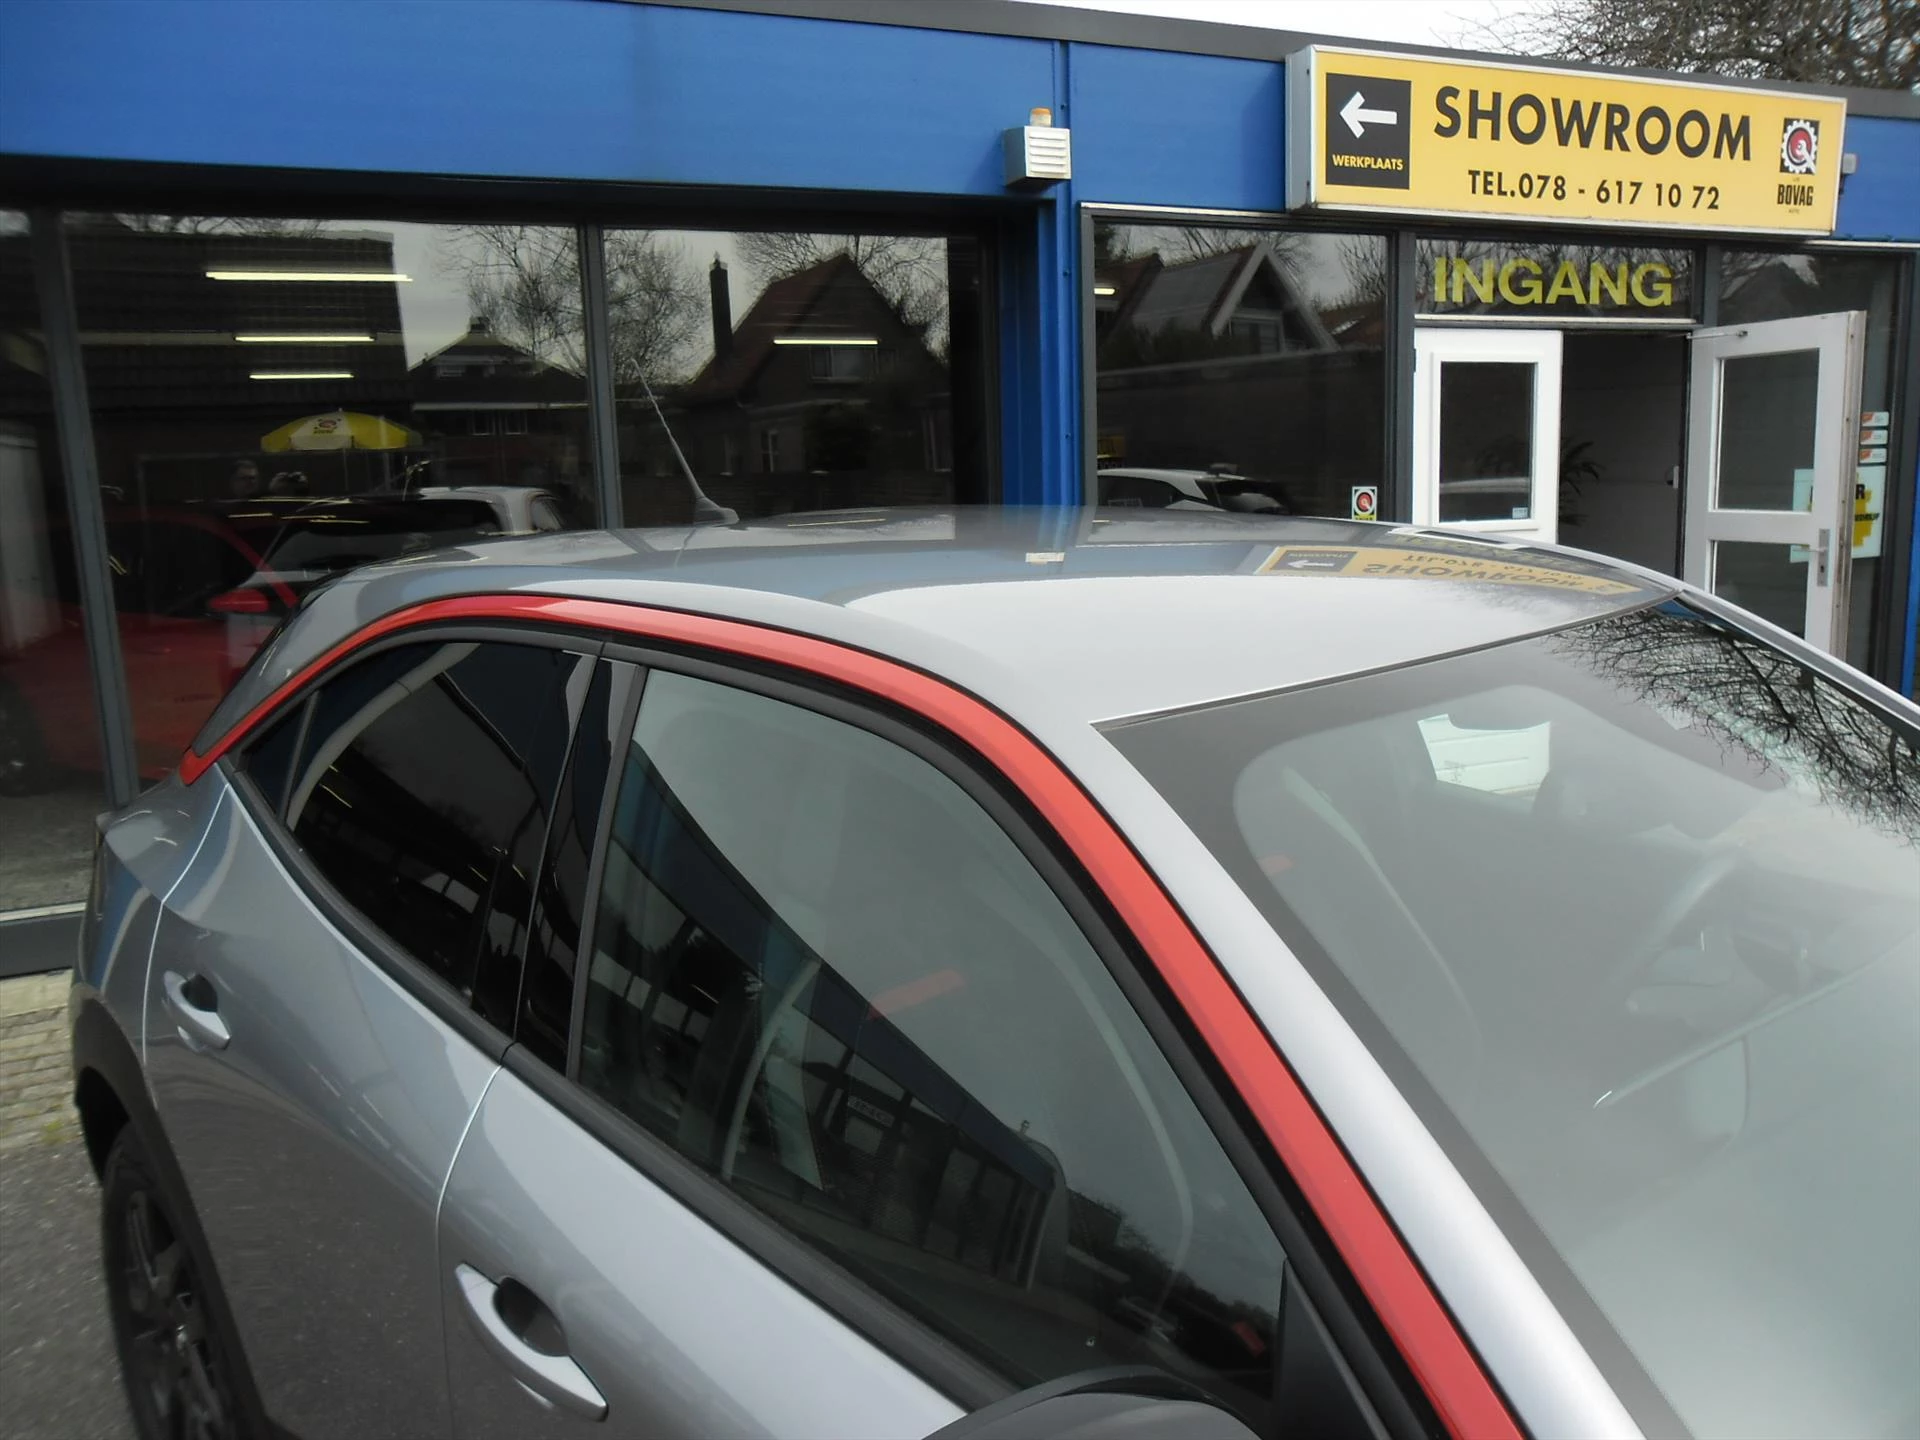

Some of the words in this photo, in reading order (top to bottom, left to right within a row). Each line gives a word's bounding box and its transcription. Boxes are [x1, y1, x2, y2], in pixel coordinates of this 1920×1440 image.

[1433, 85, 1752, 162] SHOWROOM
[1332, 153, 1404, 171] WERKPLAATS
[1595, 179, 1644, 205] 617
[1655, 182, 1682, 208] 10
[1691, 185, 1720, 210] 72
[1776, 183, 1814, 206] BOVAG
[1434, 256, 1673, 307] INGANG
